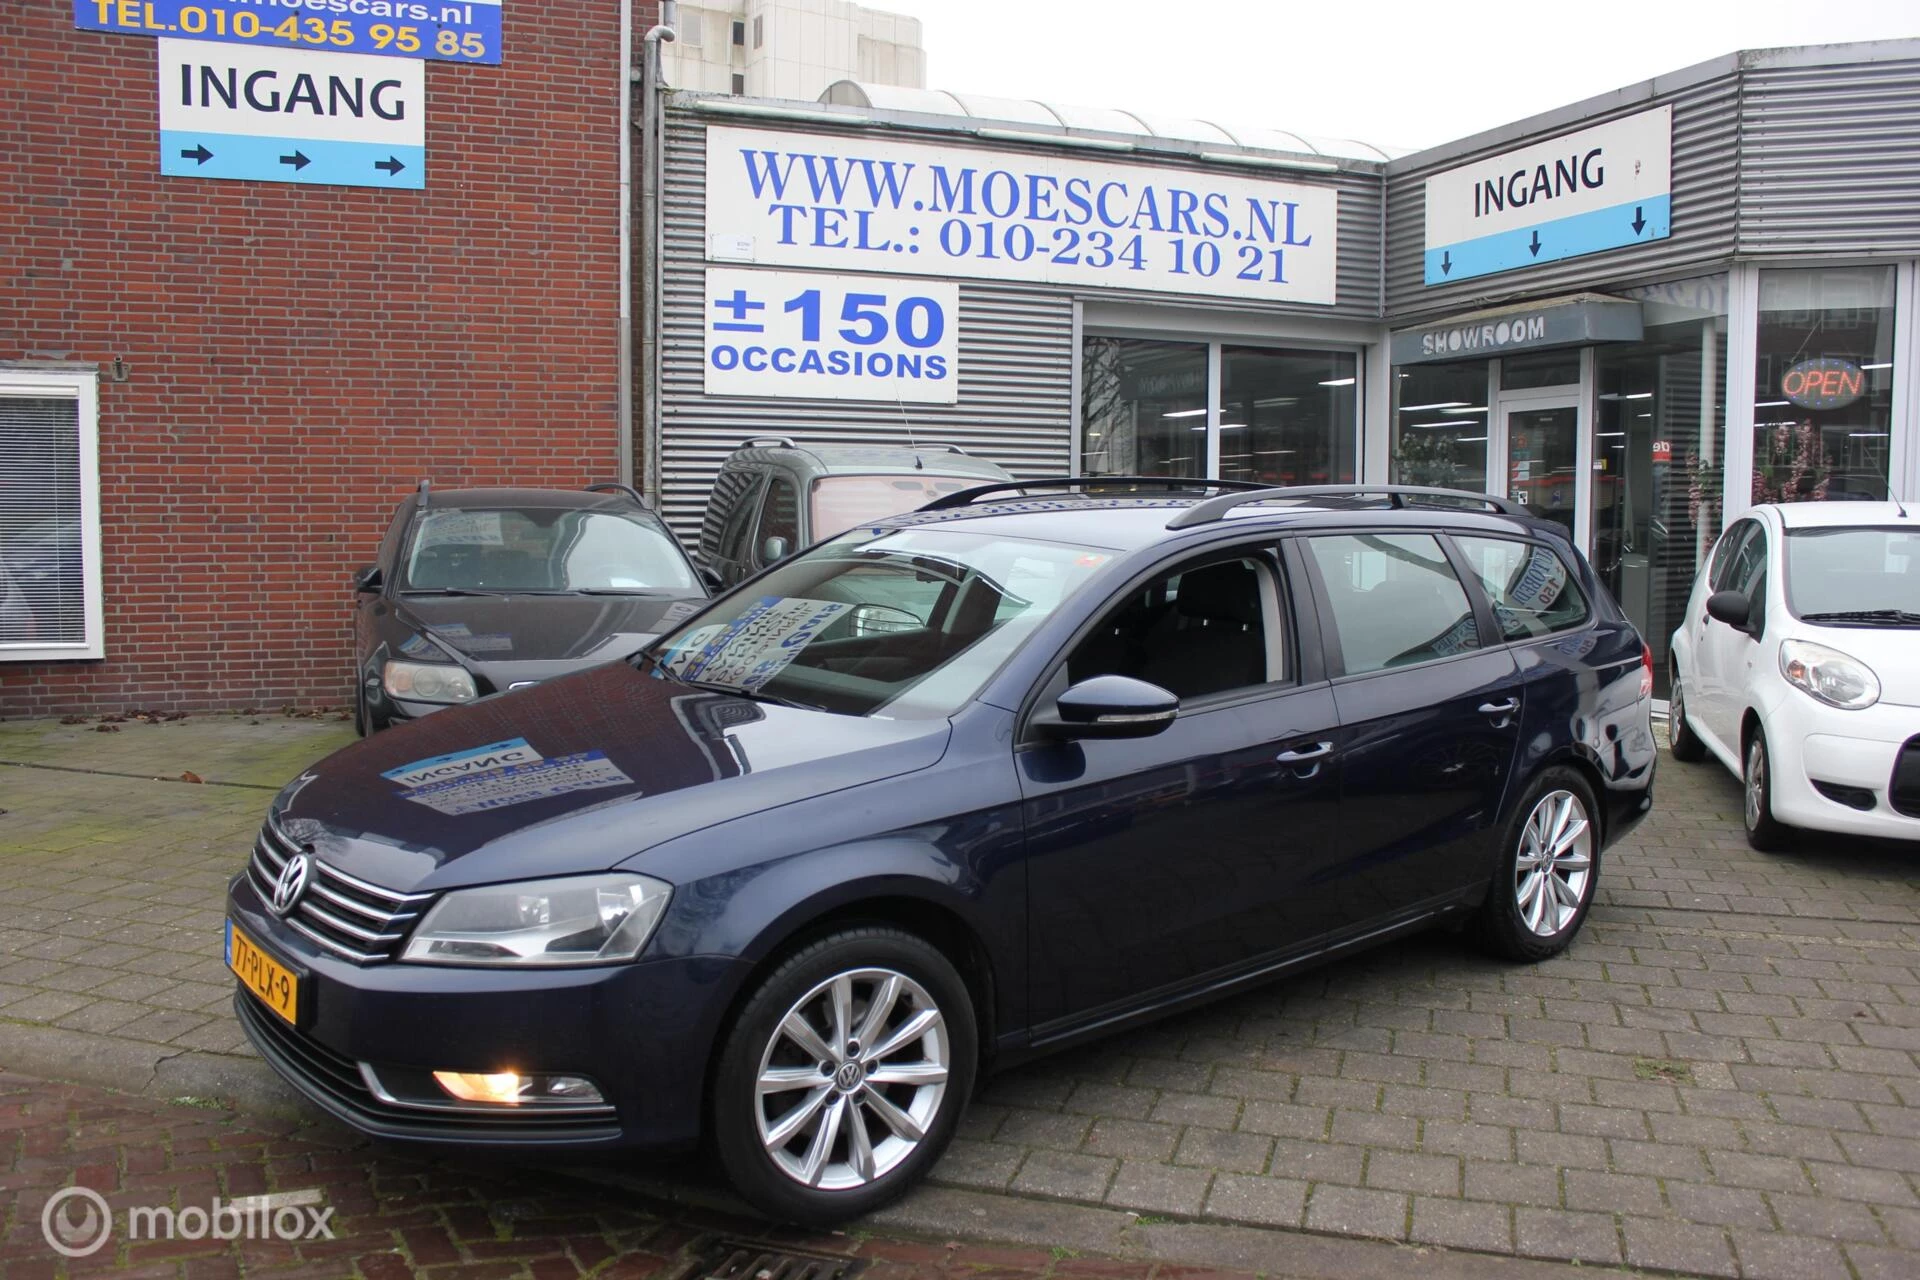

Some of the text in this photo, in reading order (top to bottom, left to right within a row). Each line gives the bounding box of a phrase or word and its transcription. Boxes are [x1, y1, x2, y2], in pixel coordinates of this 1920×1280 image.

[369, 24, 421, 52] 95
[434, 30, 485, 58] 85
[181, 64, 405, 120] INGANG
[739, 148, 1312, 247] WWW.MOESCARS.NL
[1474, 148, 1605, 218] INGANG
[768, 203, 1289, 284] TEL.: 010-234 10 21
[711, 345, 948, 380] OCCASIONS
[1421, 315, 1545, 355] SHOWROOM
[1783, 369, 1864, 396] OPEN
[235, 933, 290, 1010] 77-PLX-9
